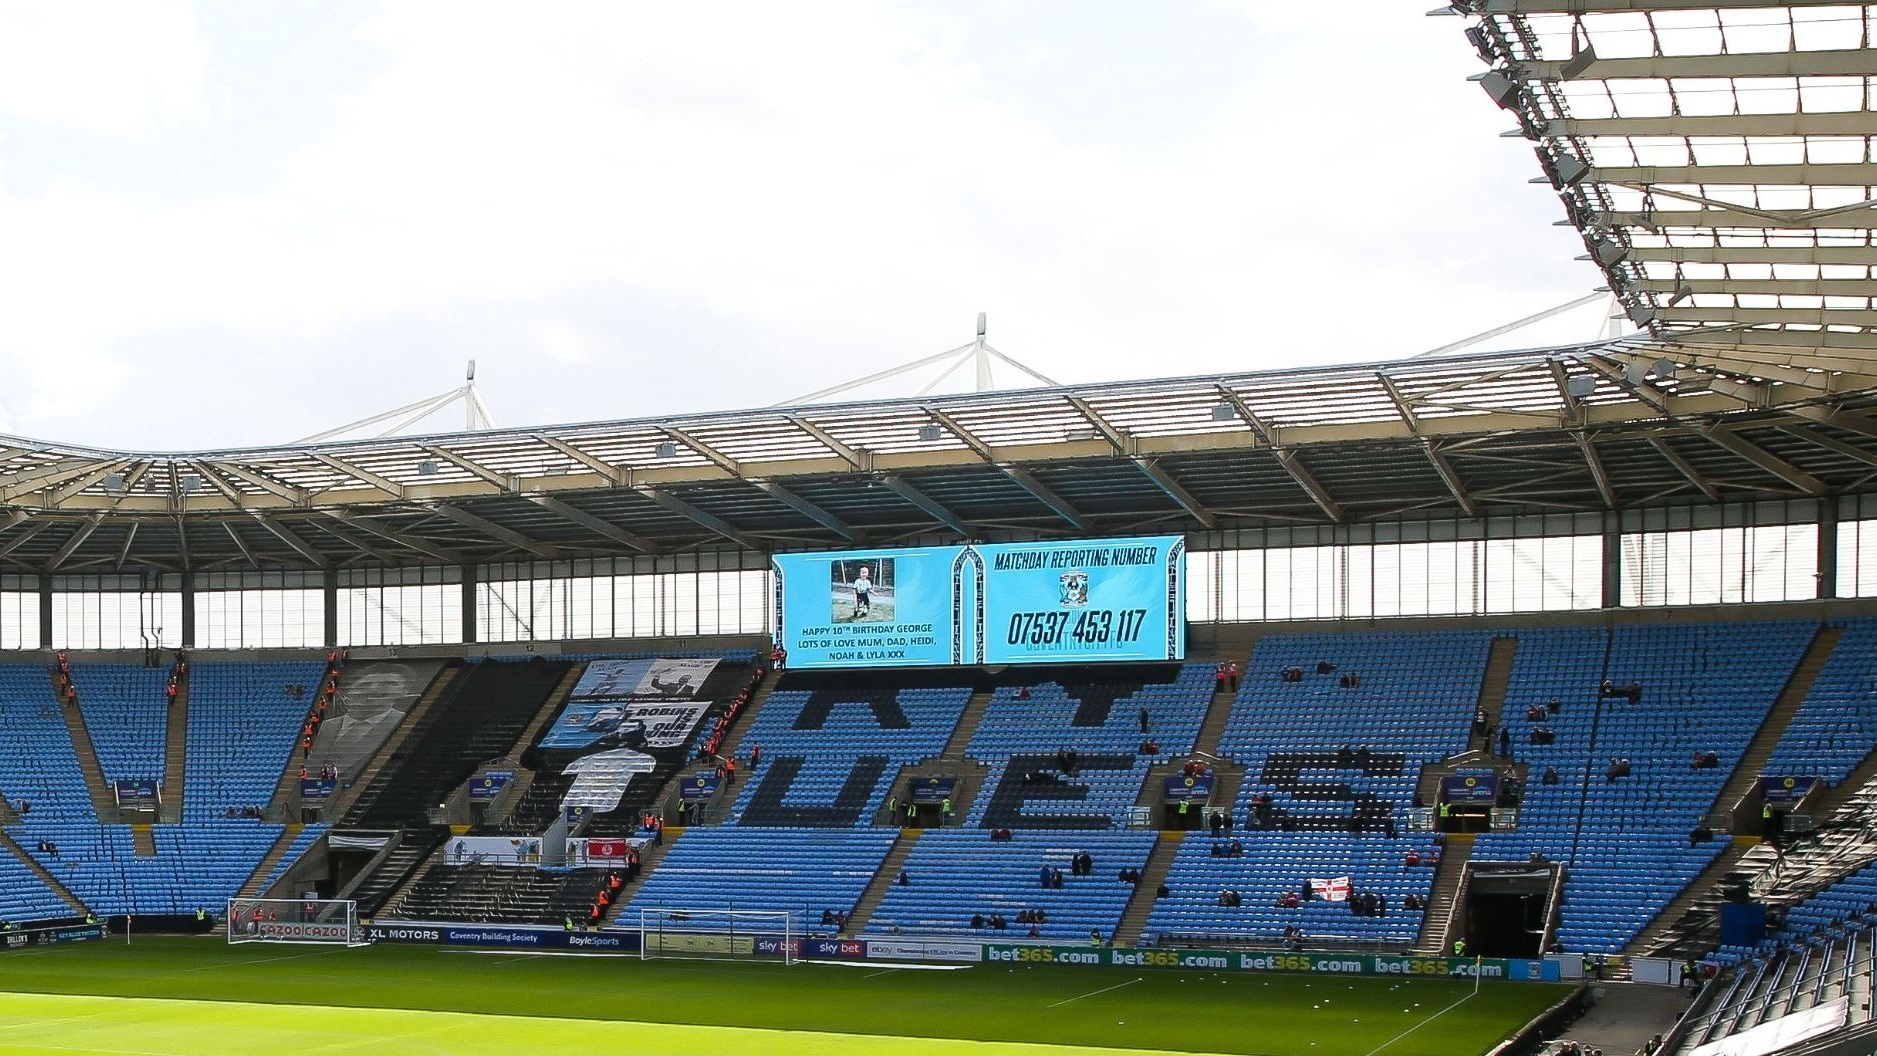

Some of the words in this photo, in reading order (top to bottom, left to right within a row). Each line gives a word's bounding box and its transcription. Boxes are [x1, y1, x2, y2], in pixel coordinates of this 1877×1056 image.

[994, 551, 1049, 570] MATCHDAY
[1050, 549, 1108, 568] REPORTING
[1111, 546, 1157, 566] NUMBER
[802, 626, 830, 636] HAPPY
[852, 625, 894, 635] BIRTHDAY
[897, 624, 932, 633] GEORGE
[1007, 612, 1069, 645] 07537
[1072, 610, 1113, 643] 453
[1116, 609, 1148, 642] 117
[798, 639, 819, 648] LOTS
[820, 639, 832, 648] OF
[834, 638, 855, 647] LOVE
[857, 637, 884, 647] MUM,
[886, 637, 908, 646] DAD,
[910, 636, 937, 645] HEIDI,
[829, 651, 854, 660] NOAH
[856, 651, 864, 659] &
[866, 651, 885, 659] LYLA
[887, 650, 905, 658] XXX
[636, 707, 699, 717] ROBINS
[653, 722, 688, 731] OUR
[370, 929, 386, 939] XL
[389, 929, 439, 940] MOTORS
[449, 931, 481, 942] Coventry
[482, 932, 511, 942] Building
[512, 933, 538, 943] Society
[569, 935, 619, 947] BoyleSports
[759, 941, 777, 951] sky
[780, 940, 798, 951] bet
[819, 943, 838, 954] sky
[841, 942, 860, 953] bet
[989, 945, 1100, 965] bet365.com
[1112, 948, 1227, 969] bet365.com
[1240, 951, 1362, 973] bet365.com
[1375, 955, 1502, 977] bet365.com
